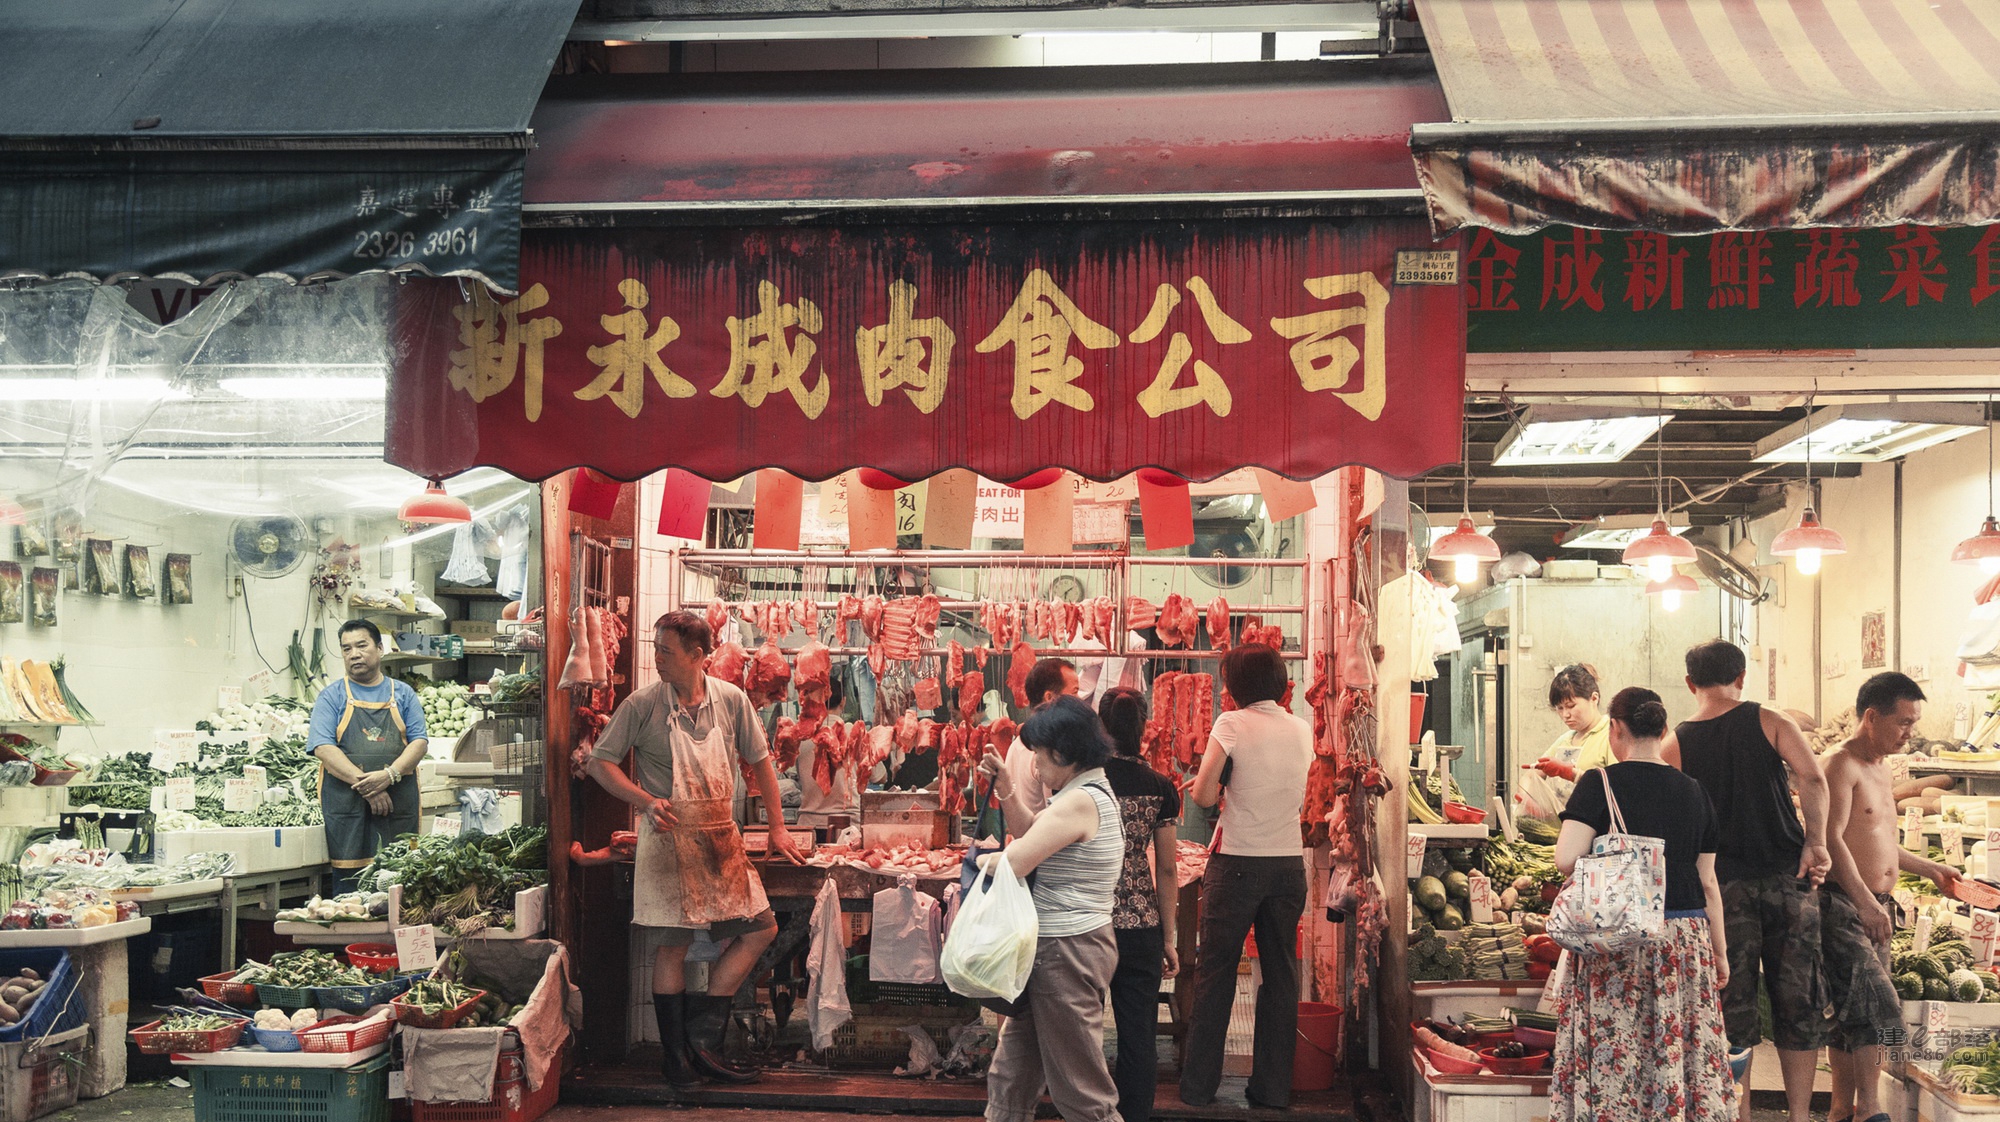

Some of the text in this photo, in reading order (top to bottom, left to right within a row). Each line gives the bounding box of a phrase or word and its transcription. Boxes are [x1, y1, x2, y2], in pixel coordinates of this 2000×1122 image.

[353, 227, 478, 258] 2326 3961
[1400, 271, 1454, 280] 23935667
[448, 268, 1390, 422] 新永成肉食公司
[977, 488, 1021, 498] EAT FOR
[1106, 485, 1124, 497] 20
[974, 506, 1019, 523] 肉出
[898, 513, 915, 531] 16
[1987, 831, 2000, 842] 10
[412, 938, 430, 951] 5元
[240, 1074, 301, 1090] 有机种植
